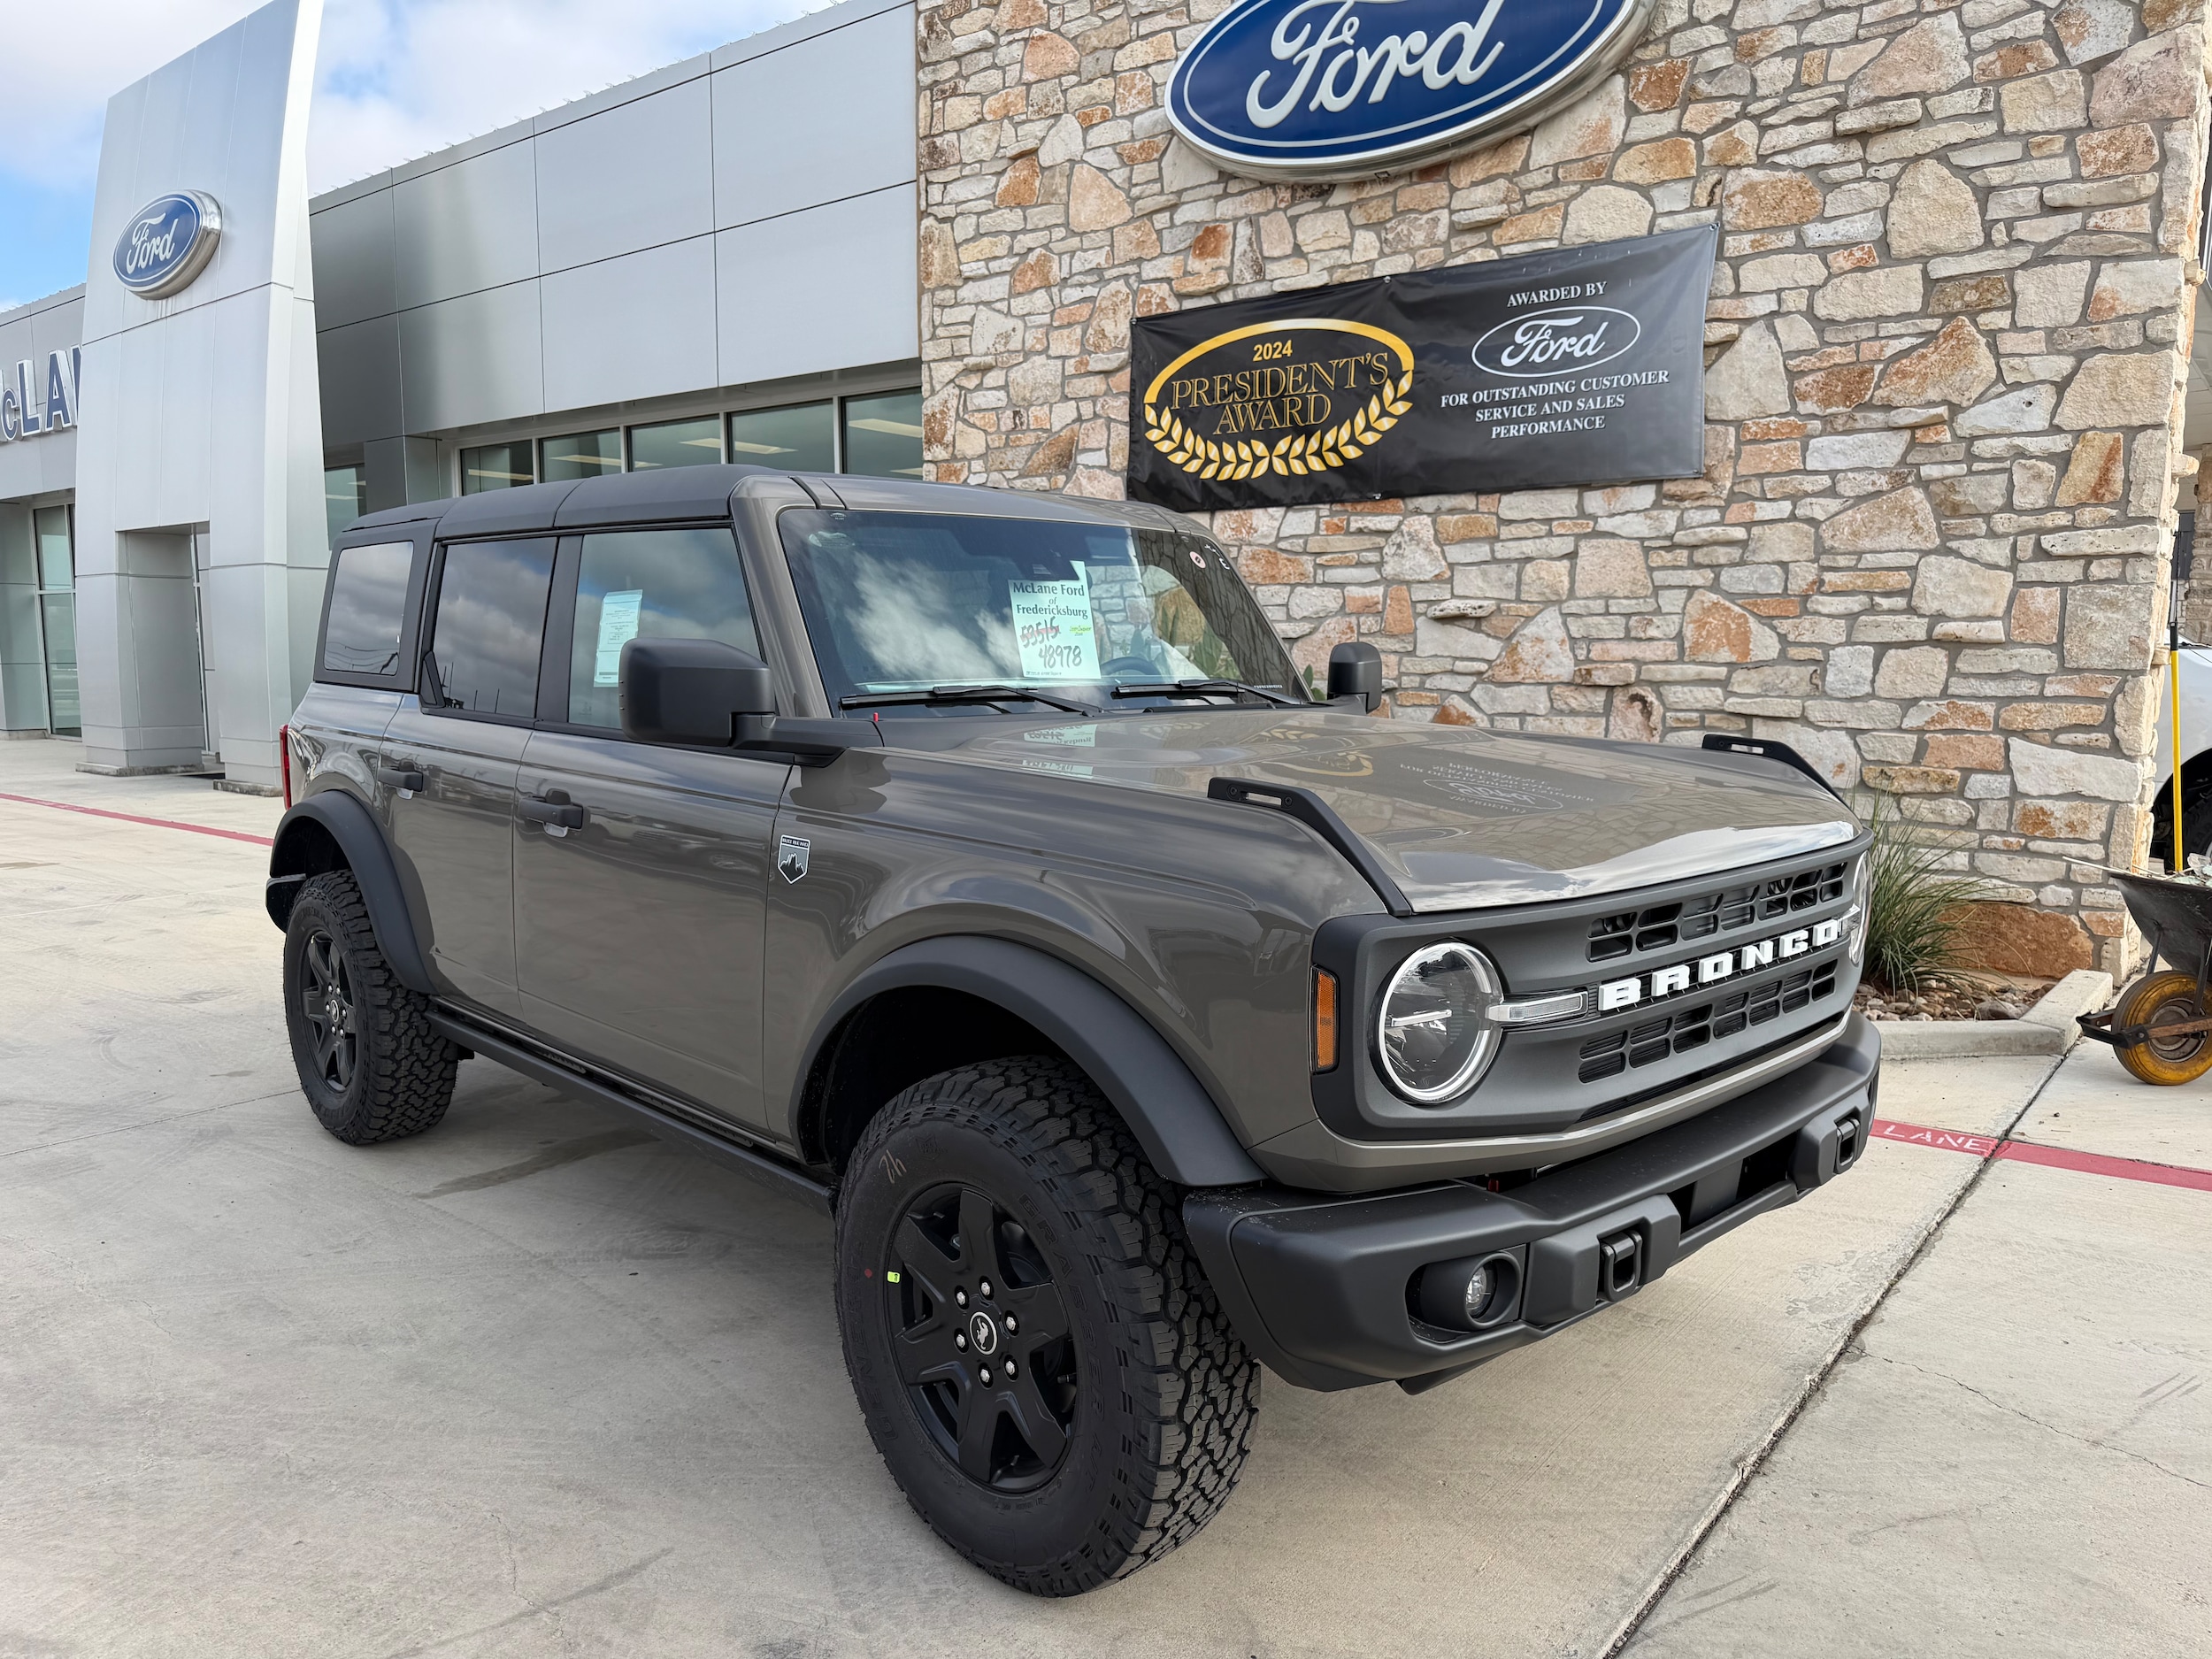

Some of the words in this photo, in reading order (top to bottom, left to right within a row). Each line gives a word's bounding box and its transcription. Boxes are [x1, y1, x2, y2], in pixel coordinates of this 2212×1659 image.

[1246, 0, 1504, 128] Ford
[126, 212, 179, 274] Ford
[1507, 285, 1581, 308] AWARDED
[1586, 281, 1608, 297] BY
[1252, 340, 1293, 362] 2024
[1501, 316, 1609, 366] Ford
[1171, 352, 1389, 411] PRESIDENT'S
[1440, 393, 1469, 408] FOR
[1472, 380, 1577, 404] OUTSTANDING
[1580, 370, 1670, 393] CUSTOMER
[1213, 393, 1332, 435] AWARD
[1475, 404, 1538, 423] SERVICE
[1540, 399, 1573, 416] AND
[1576, 394, 1625, 412] SALES
[1491, 415, 1606, 440] PERFORMANCE
[1013, 582, 1057, 595] McLane
[1061, 584, 1085, 596] Ford
[1048, 596, 1058, 605] of
[1017, 604, 1088, 620] Fredericksburg
[1039, 643, 1082, 669] 48978
[1598, 919, 1839, 1011] BRONCO
[1883, 1125, 1996, 1153] LANE
